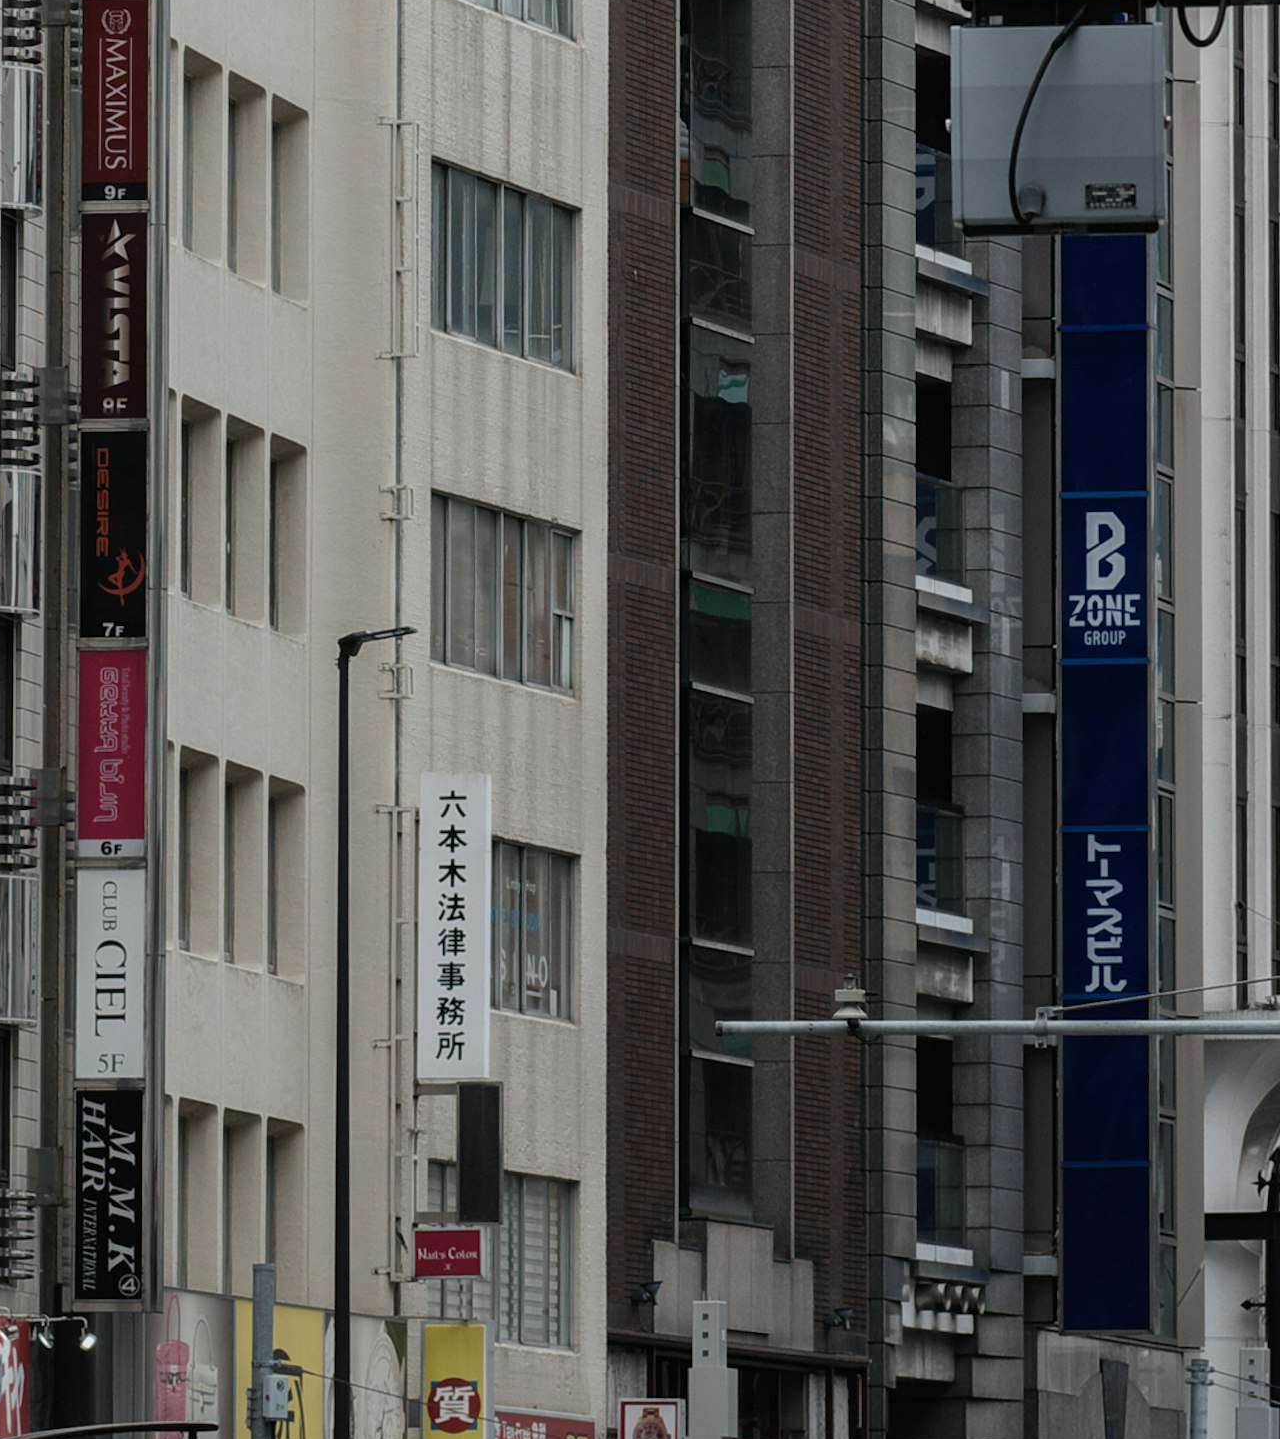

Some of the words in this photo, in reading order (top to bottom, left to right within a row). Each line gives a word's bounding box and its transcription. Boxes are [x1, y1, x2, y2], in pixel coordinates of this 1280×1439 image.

[104, 37, 127, 171] MAXIMUS
[104, 184, 126, 200] 9F
[95, 448, 110, 556] DESIRE
[102, 624, 124, 637] 7F
[1069, 593, 1141, 627] ZONE
[1083, 630, 1127, 645] GROUP
[100, 840, 122, 856] 6F
[101, 880, 118, 932] CLUB
[434, 790, 468, 1061] 六本木法律事務所
[95, 941, 126, 1037] CIEL
[97, 1053, 125, 1074] 5F
[82, 1096, 106, 1192] HAIR
[108, 1125, 136, 1273] M.M.K
[82, 1198, 97, 1291] INTERNATIONAL
[433, 1385, 476, 1424] 質
